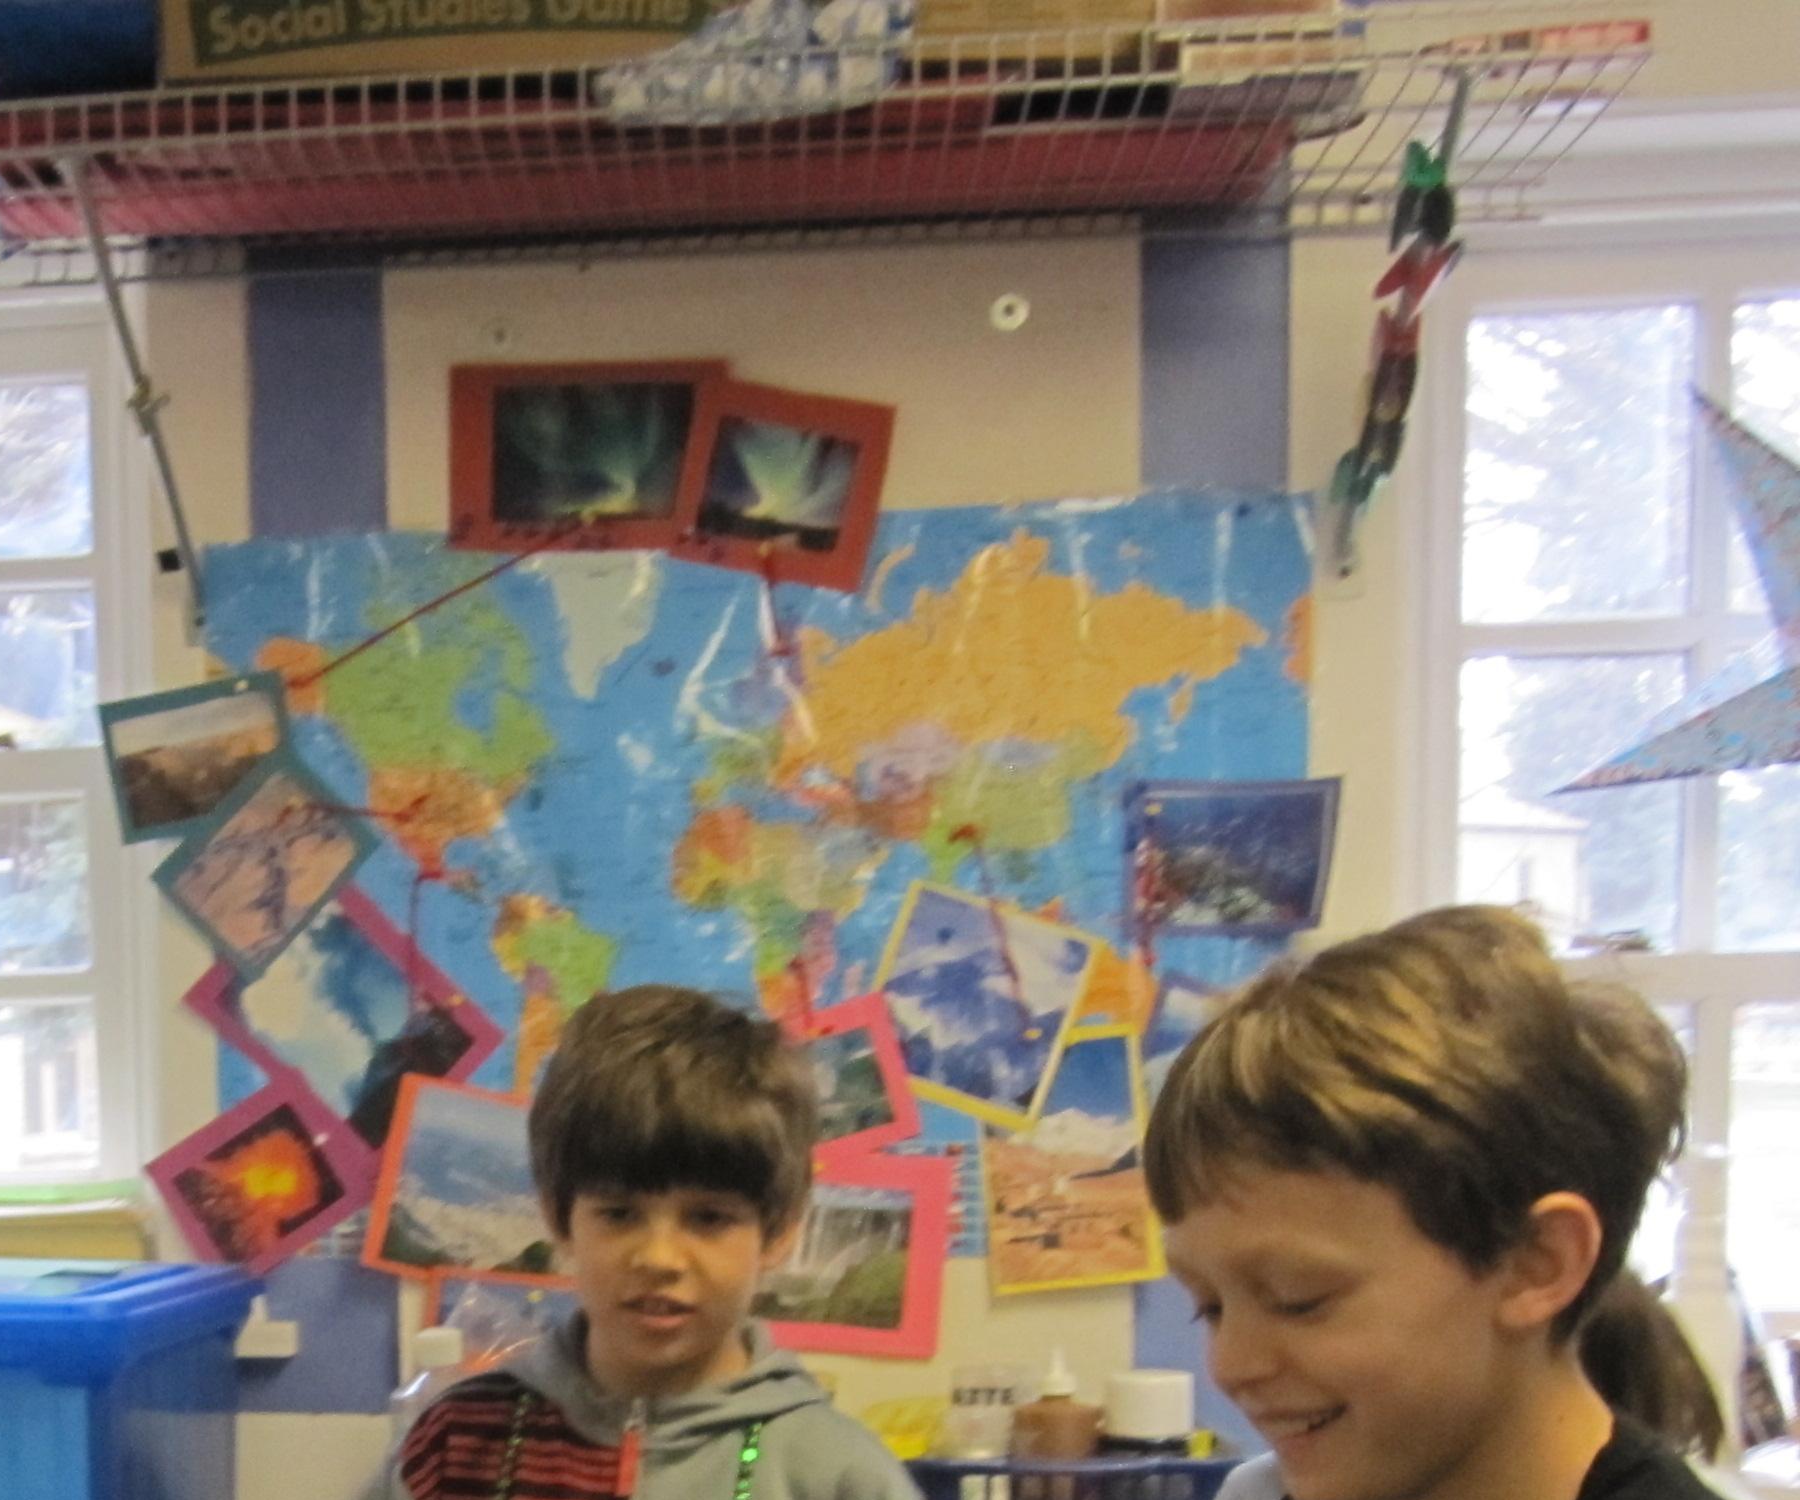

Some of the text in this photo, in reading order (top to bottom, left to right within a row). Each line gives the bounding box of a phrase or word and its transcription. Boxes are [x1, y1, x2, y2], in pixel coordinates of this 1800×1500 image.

[208, 0, 689, 54] Social Studies Game
